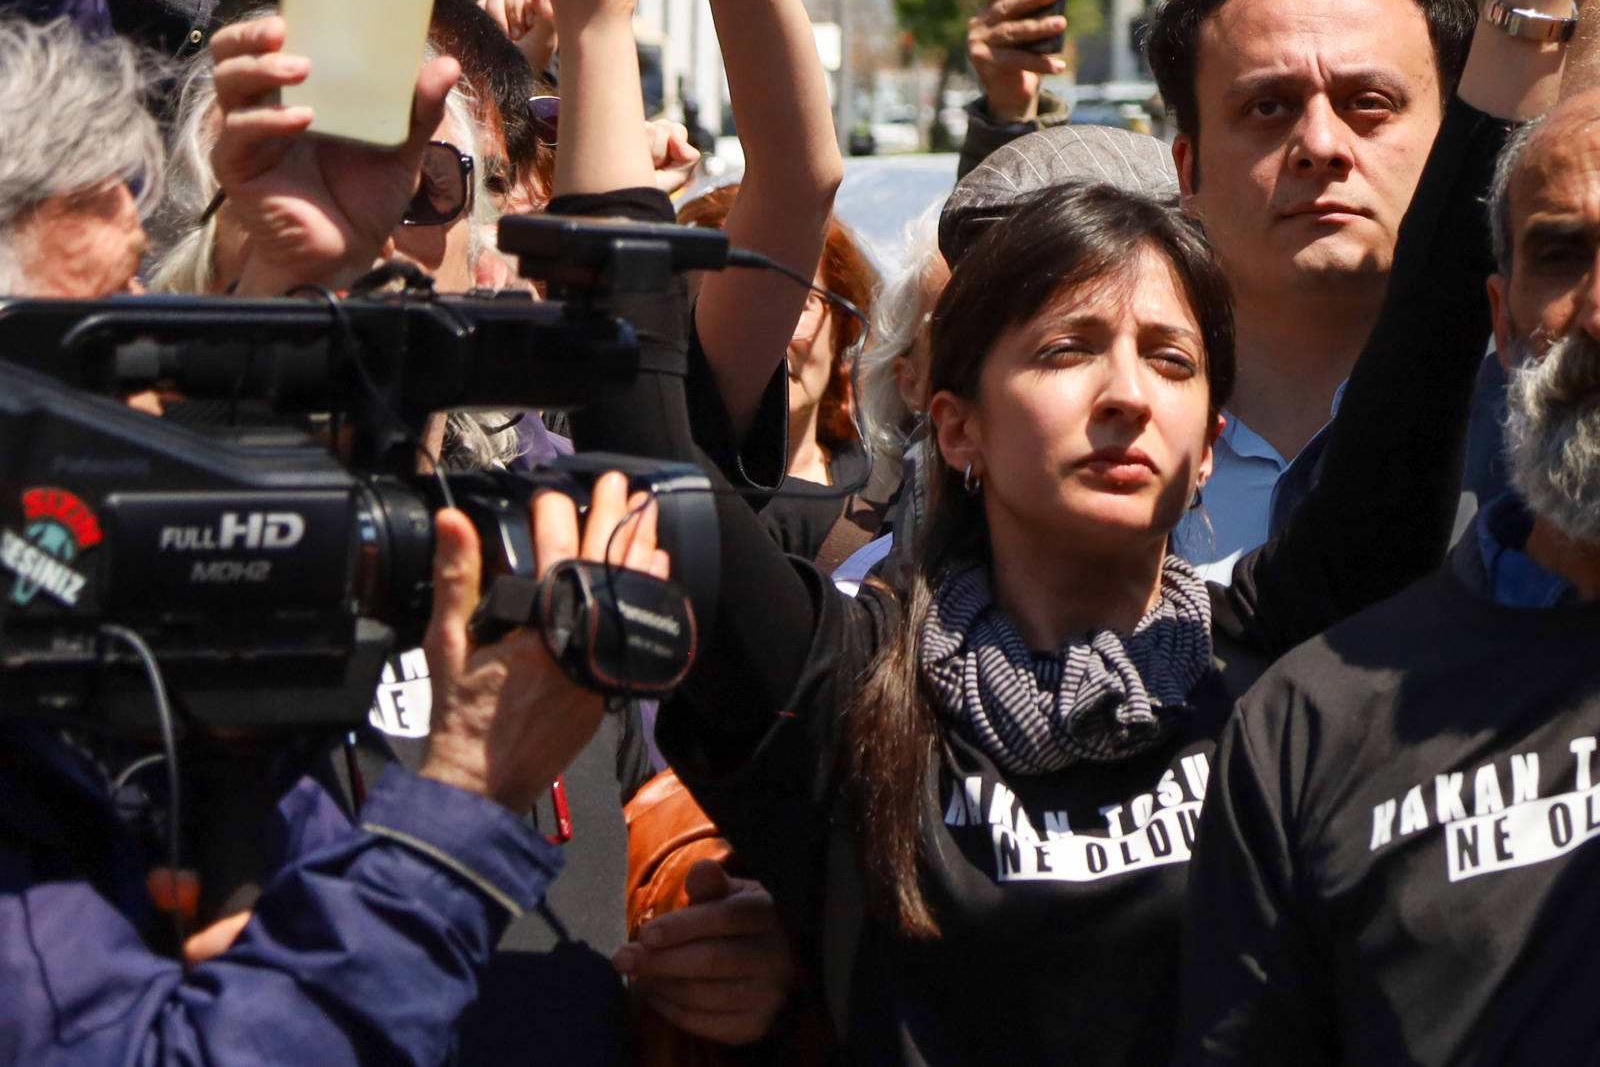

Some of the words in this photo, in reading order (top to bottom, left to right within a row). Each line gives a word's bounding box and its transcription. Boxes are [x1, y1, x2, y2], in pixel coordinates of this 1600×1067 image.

[160, 526, 216, 550] FULL
[218, 511, 306, 549] HD
[1099, 752, 1211, 839] TOSU
[1370, 752, 1541, 852] HAKAN
[1000, 829, 1053, 874] NE
[1085, 808, 1200, 874] OLDU
[1455, 816, 1514, 873] NE
